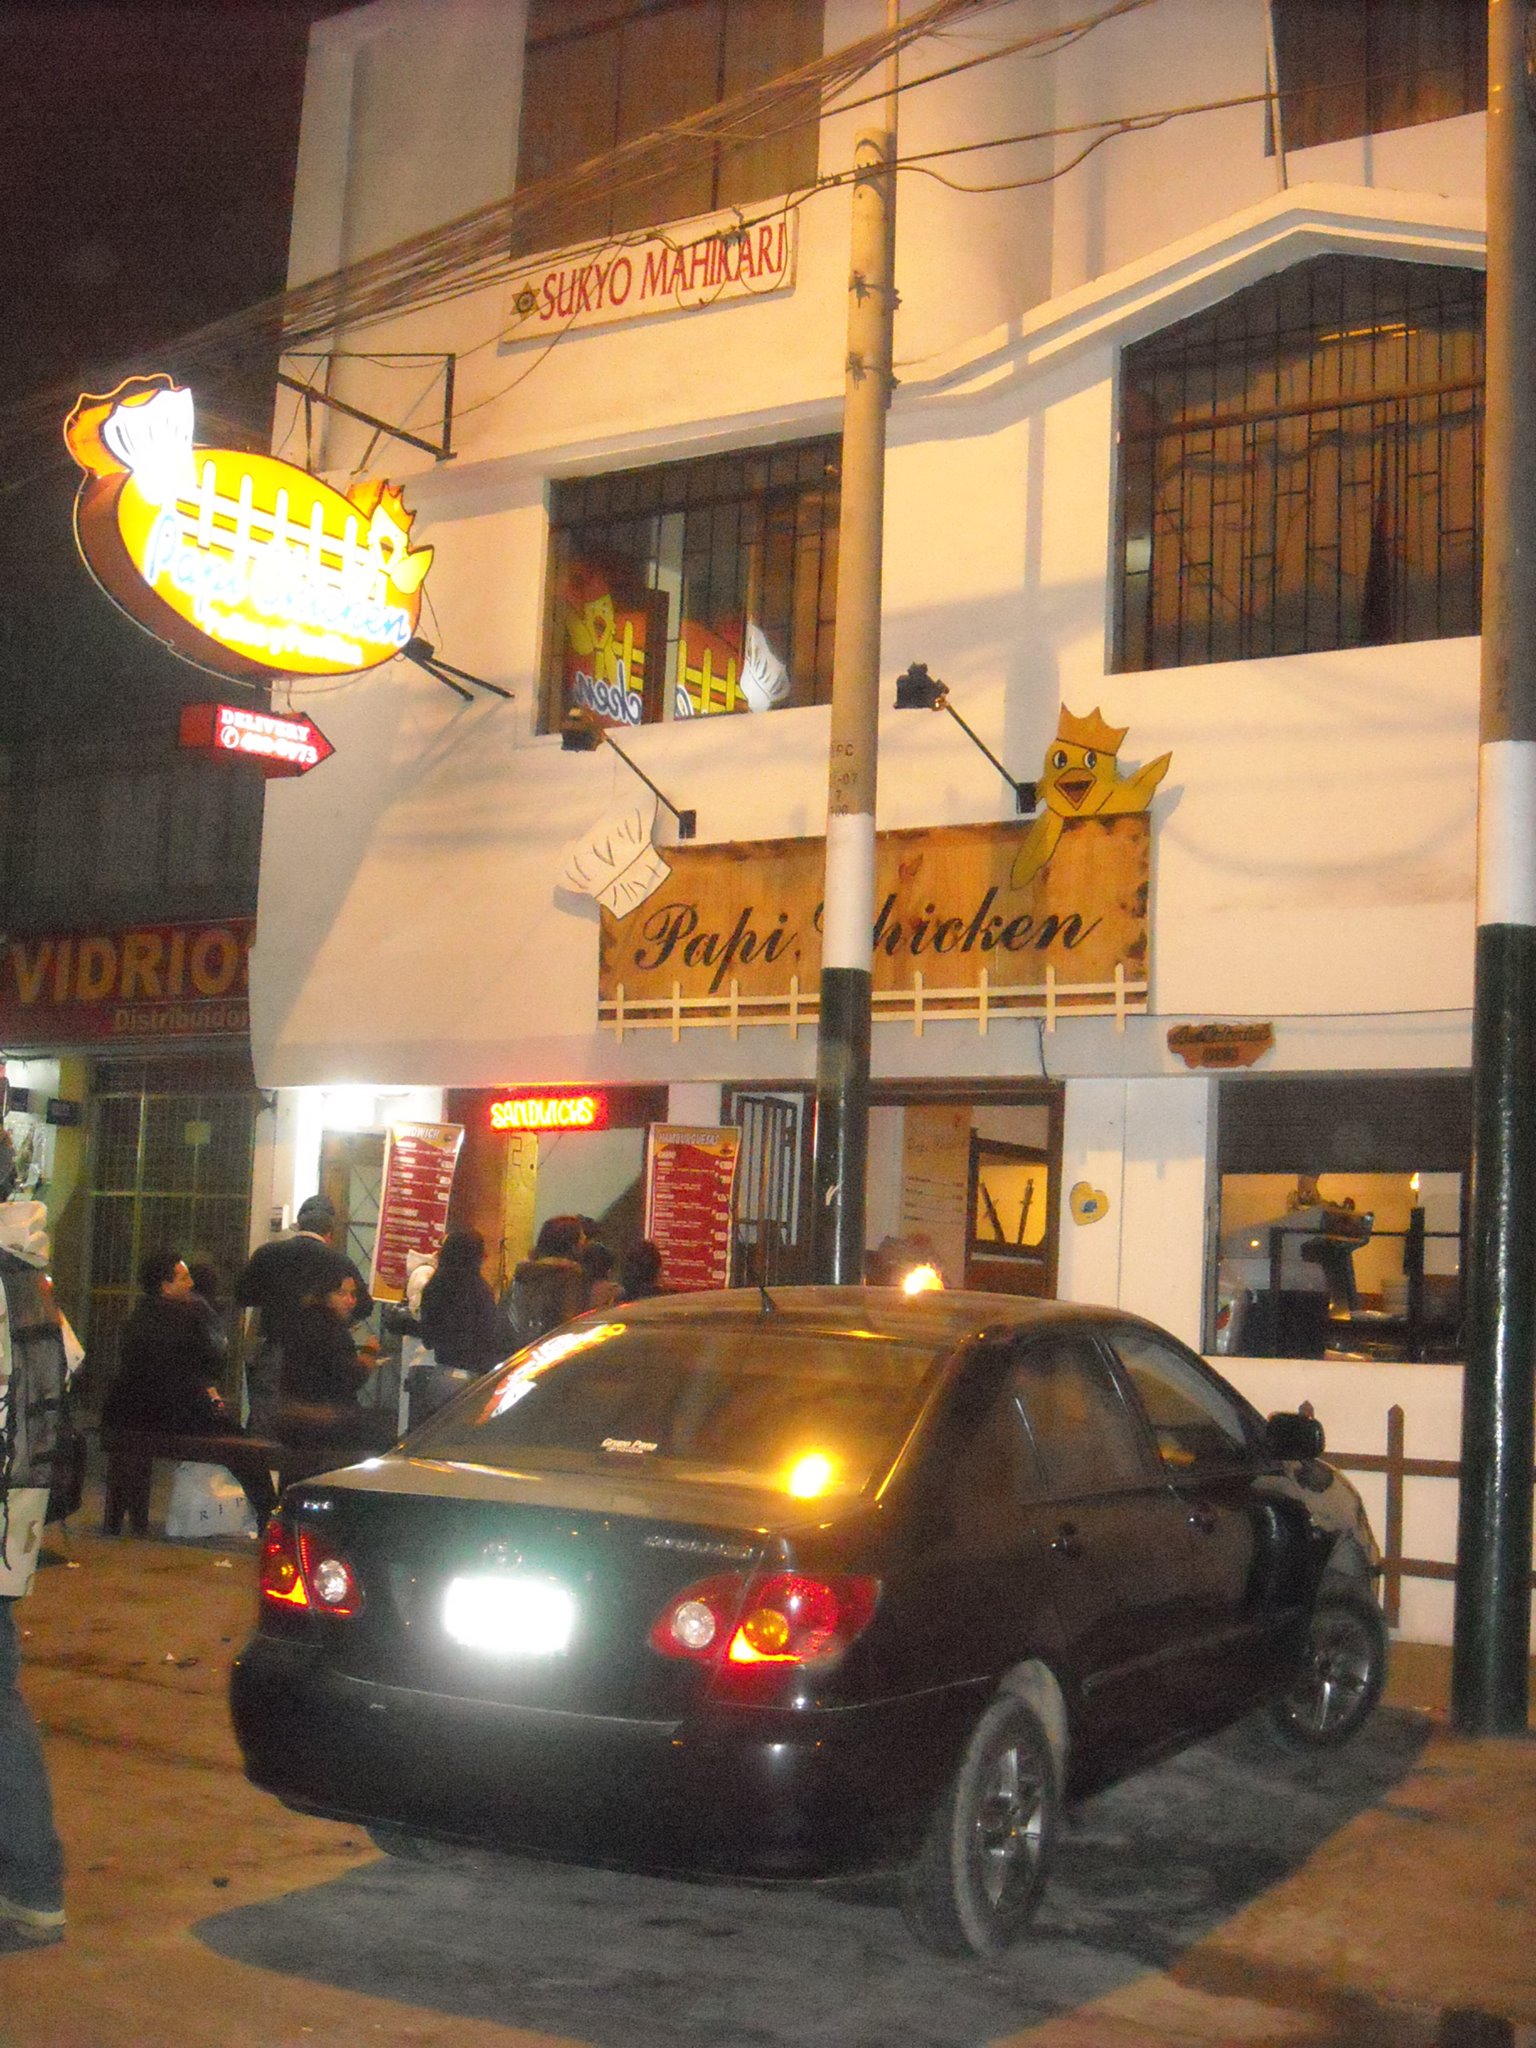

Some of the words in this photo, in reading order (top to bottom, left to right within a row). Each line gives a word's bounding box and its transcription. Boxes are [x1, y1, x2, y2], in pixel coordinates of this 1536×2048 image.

[540, 257, 632, 321] SUKYO
[640, 222, 786, 300] MAHIKARI
[220, 709, 310, 741] DELIVERY
[9, 928, 250, 1005] VIDRIO
[634, 902, 798, 994] Papi
[813, 887, 1103, 956] hicken
